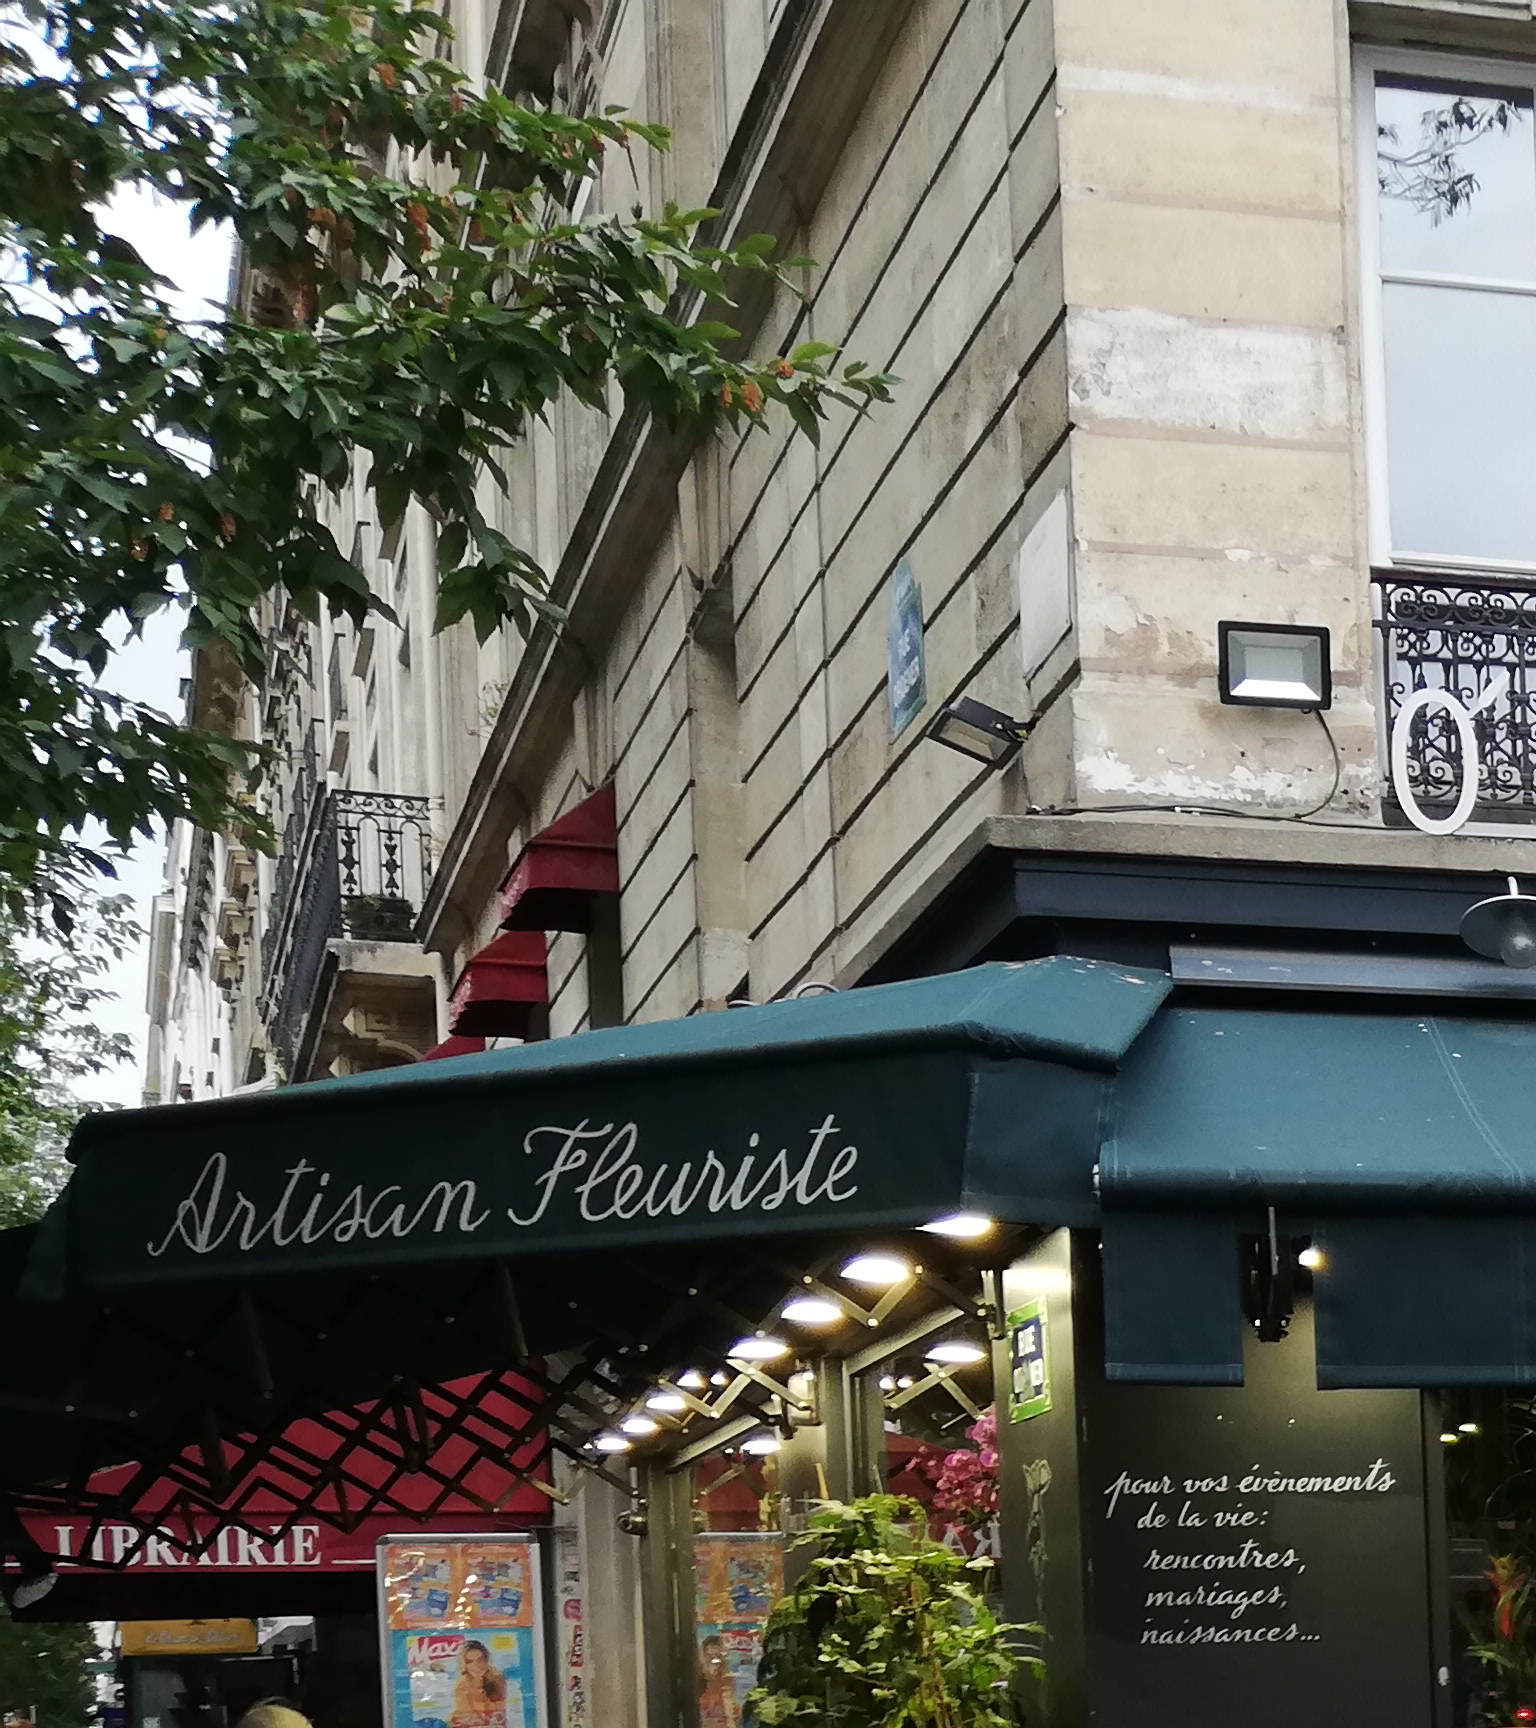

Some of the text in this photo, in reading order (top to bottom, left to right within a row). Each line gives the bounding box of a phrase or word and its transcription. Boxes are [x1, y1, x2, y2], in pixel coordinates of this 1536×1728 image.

[146, 1115, 859, 1257] Artisan Fleuriste
[1103, 1470, 1175, 1519] pour
[1183, 1474, 1230, 1494] vos
[1137, 1502, 1169, 1529] de
[1178, 1501, 1207, 1527] la
[1143, 1539, 1306, 1574] rencontres,
[1145, 1582, 1288, 1620] mariages,
